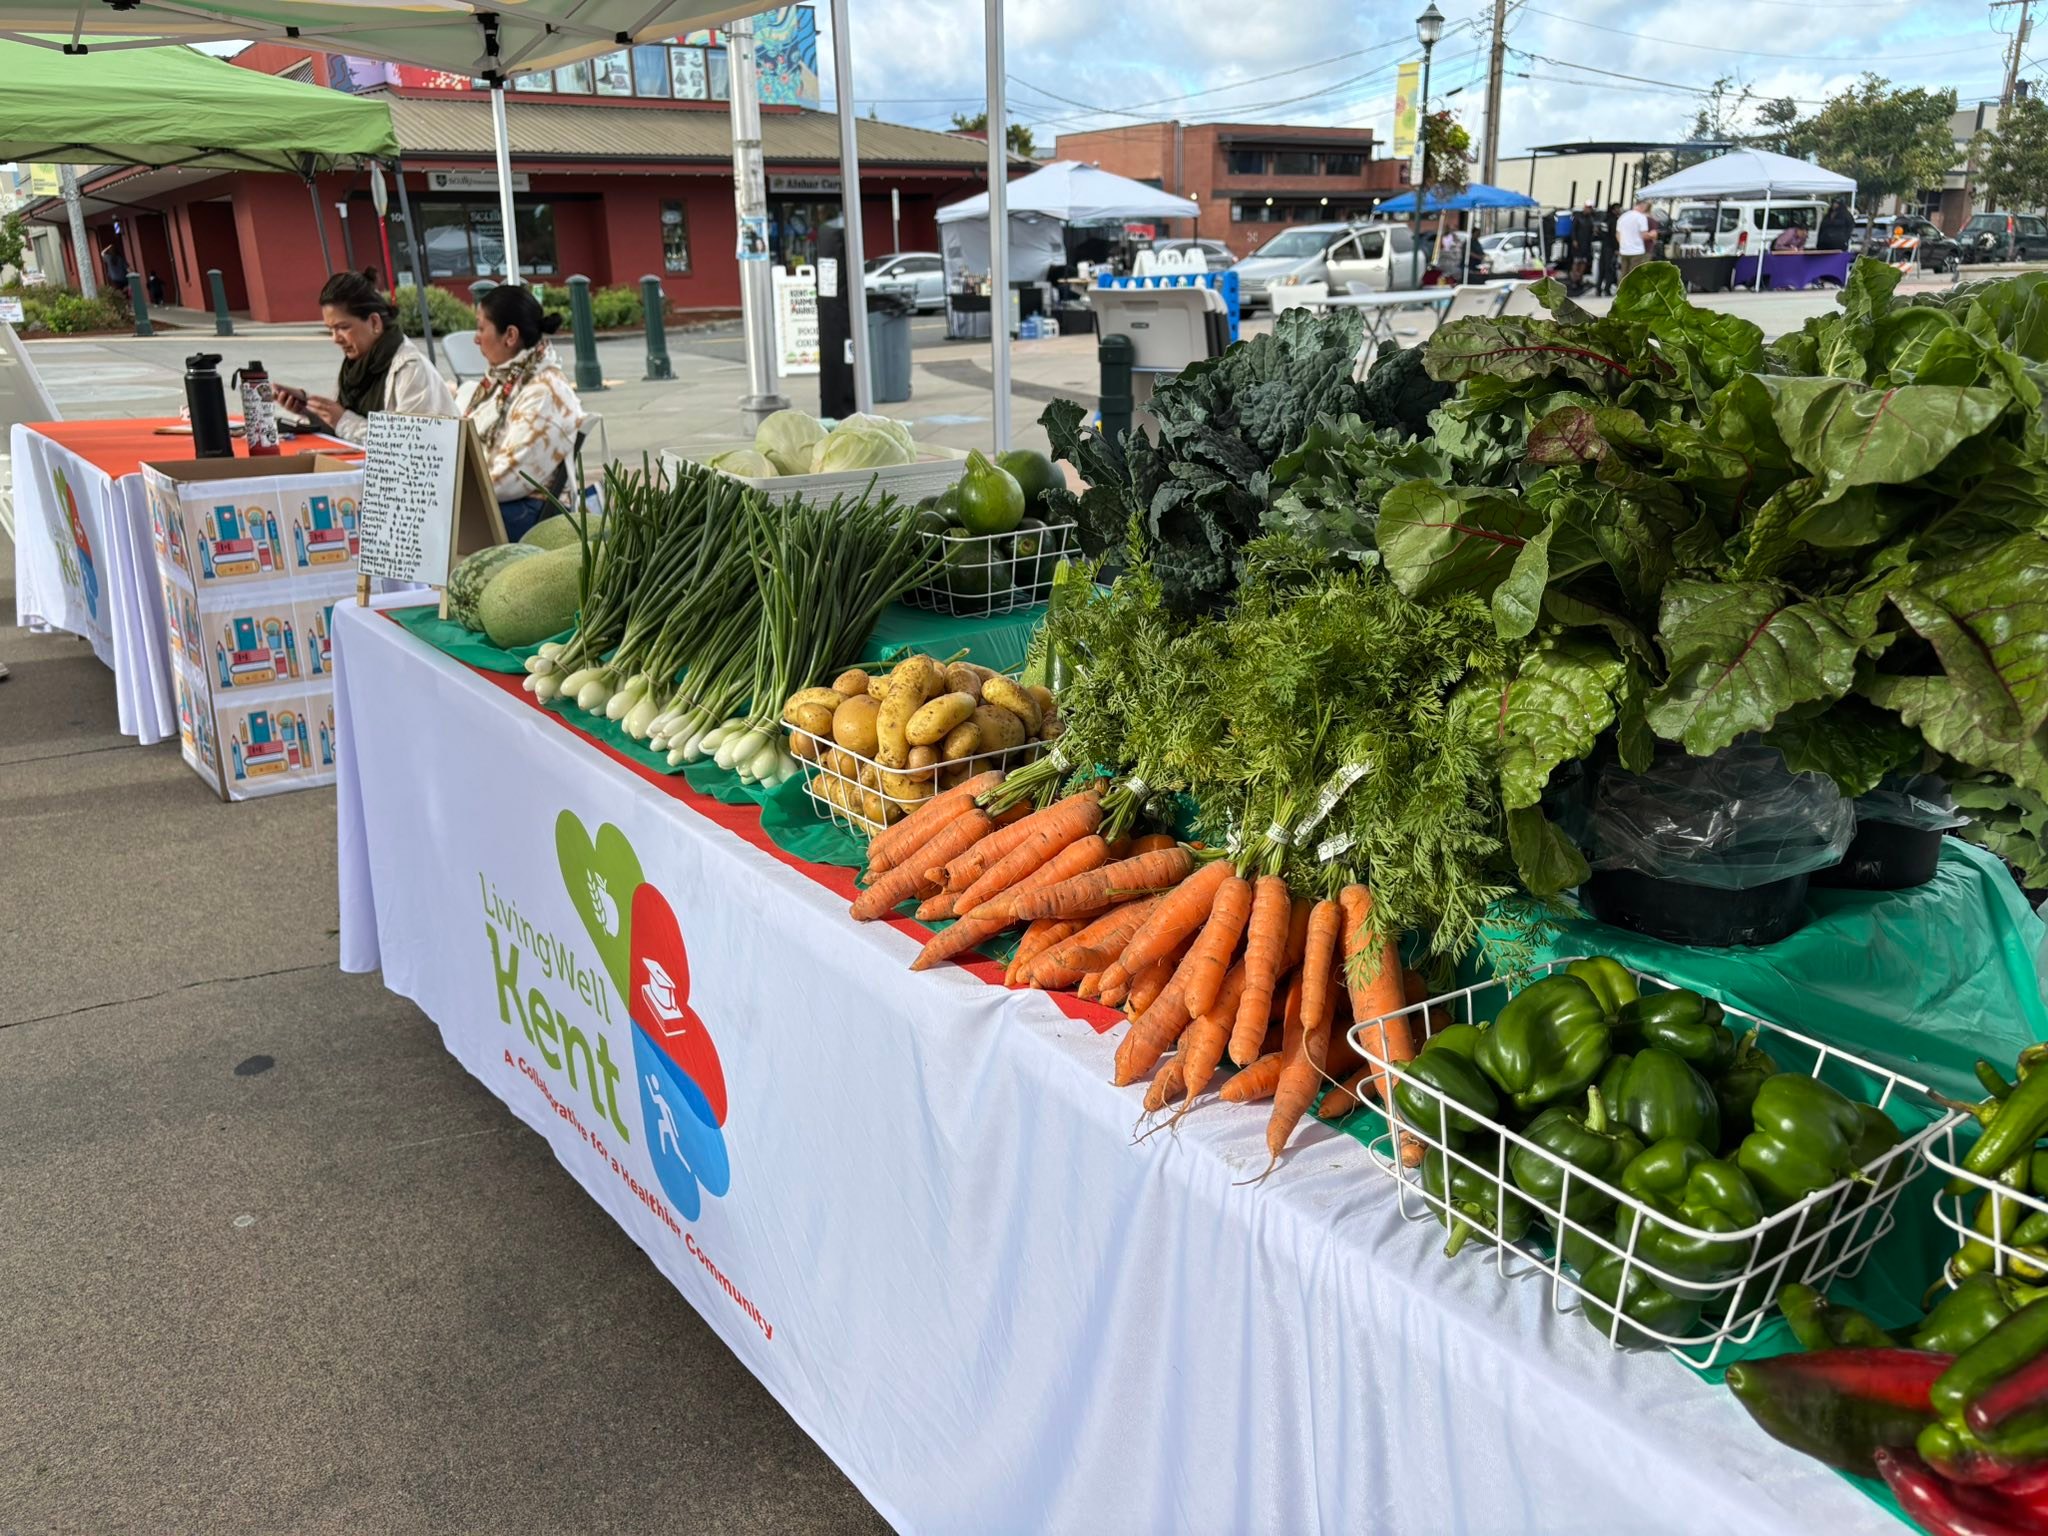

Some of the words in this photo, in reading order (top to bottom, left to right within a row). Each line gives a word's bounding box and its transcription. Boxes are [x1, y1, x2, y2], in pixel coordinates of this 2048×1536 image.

[485, 920, 631, 1145] Kent
[504, 1048, 515, 1067] A
[518, 1056, 588, 1142] Collaborative
[591, 1132, 609, 1161] for
[611, 1157, 620, 1175] a
[621, 1165, 681, 1238] Healthier
[685, 1232, 773, 1341] Community
